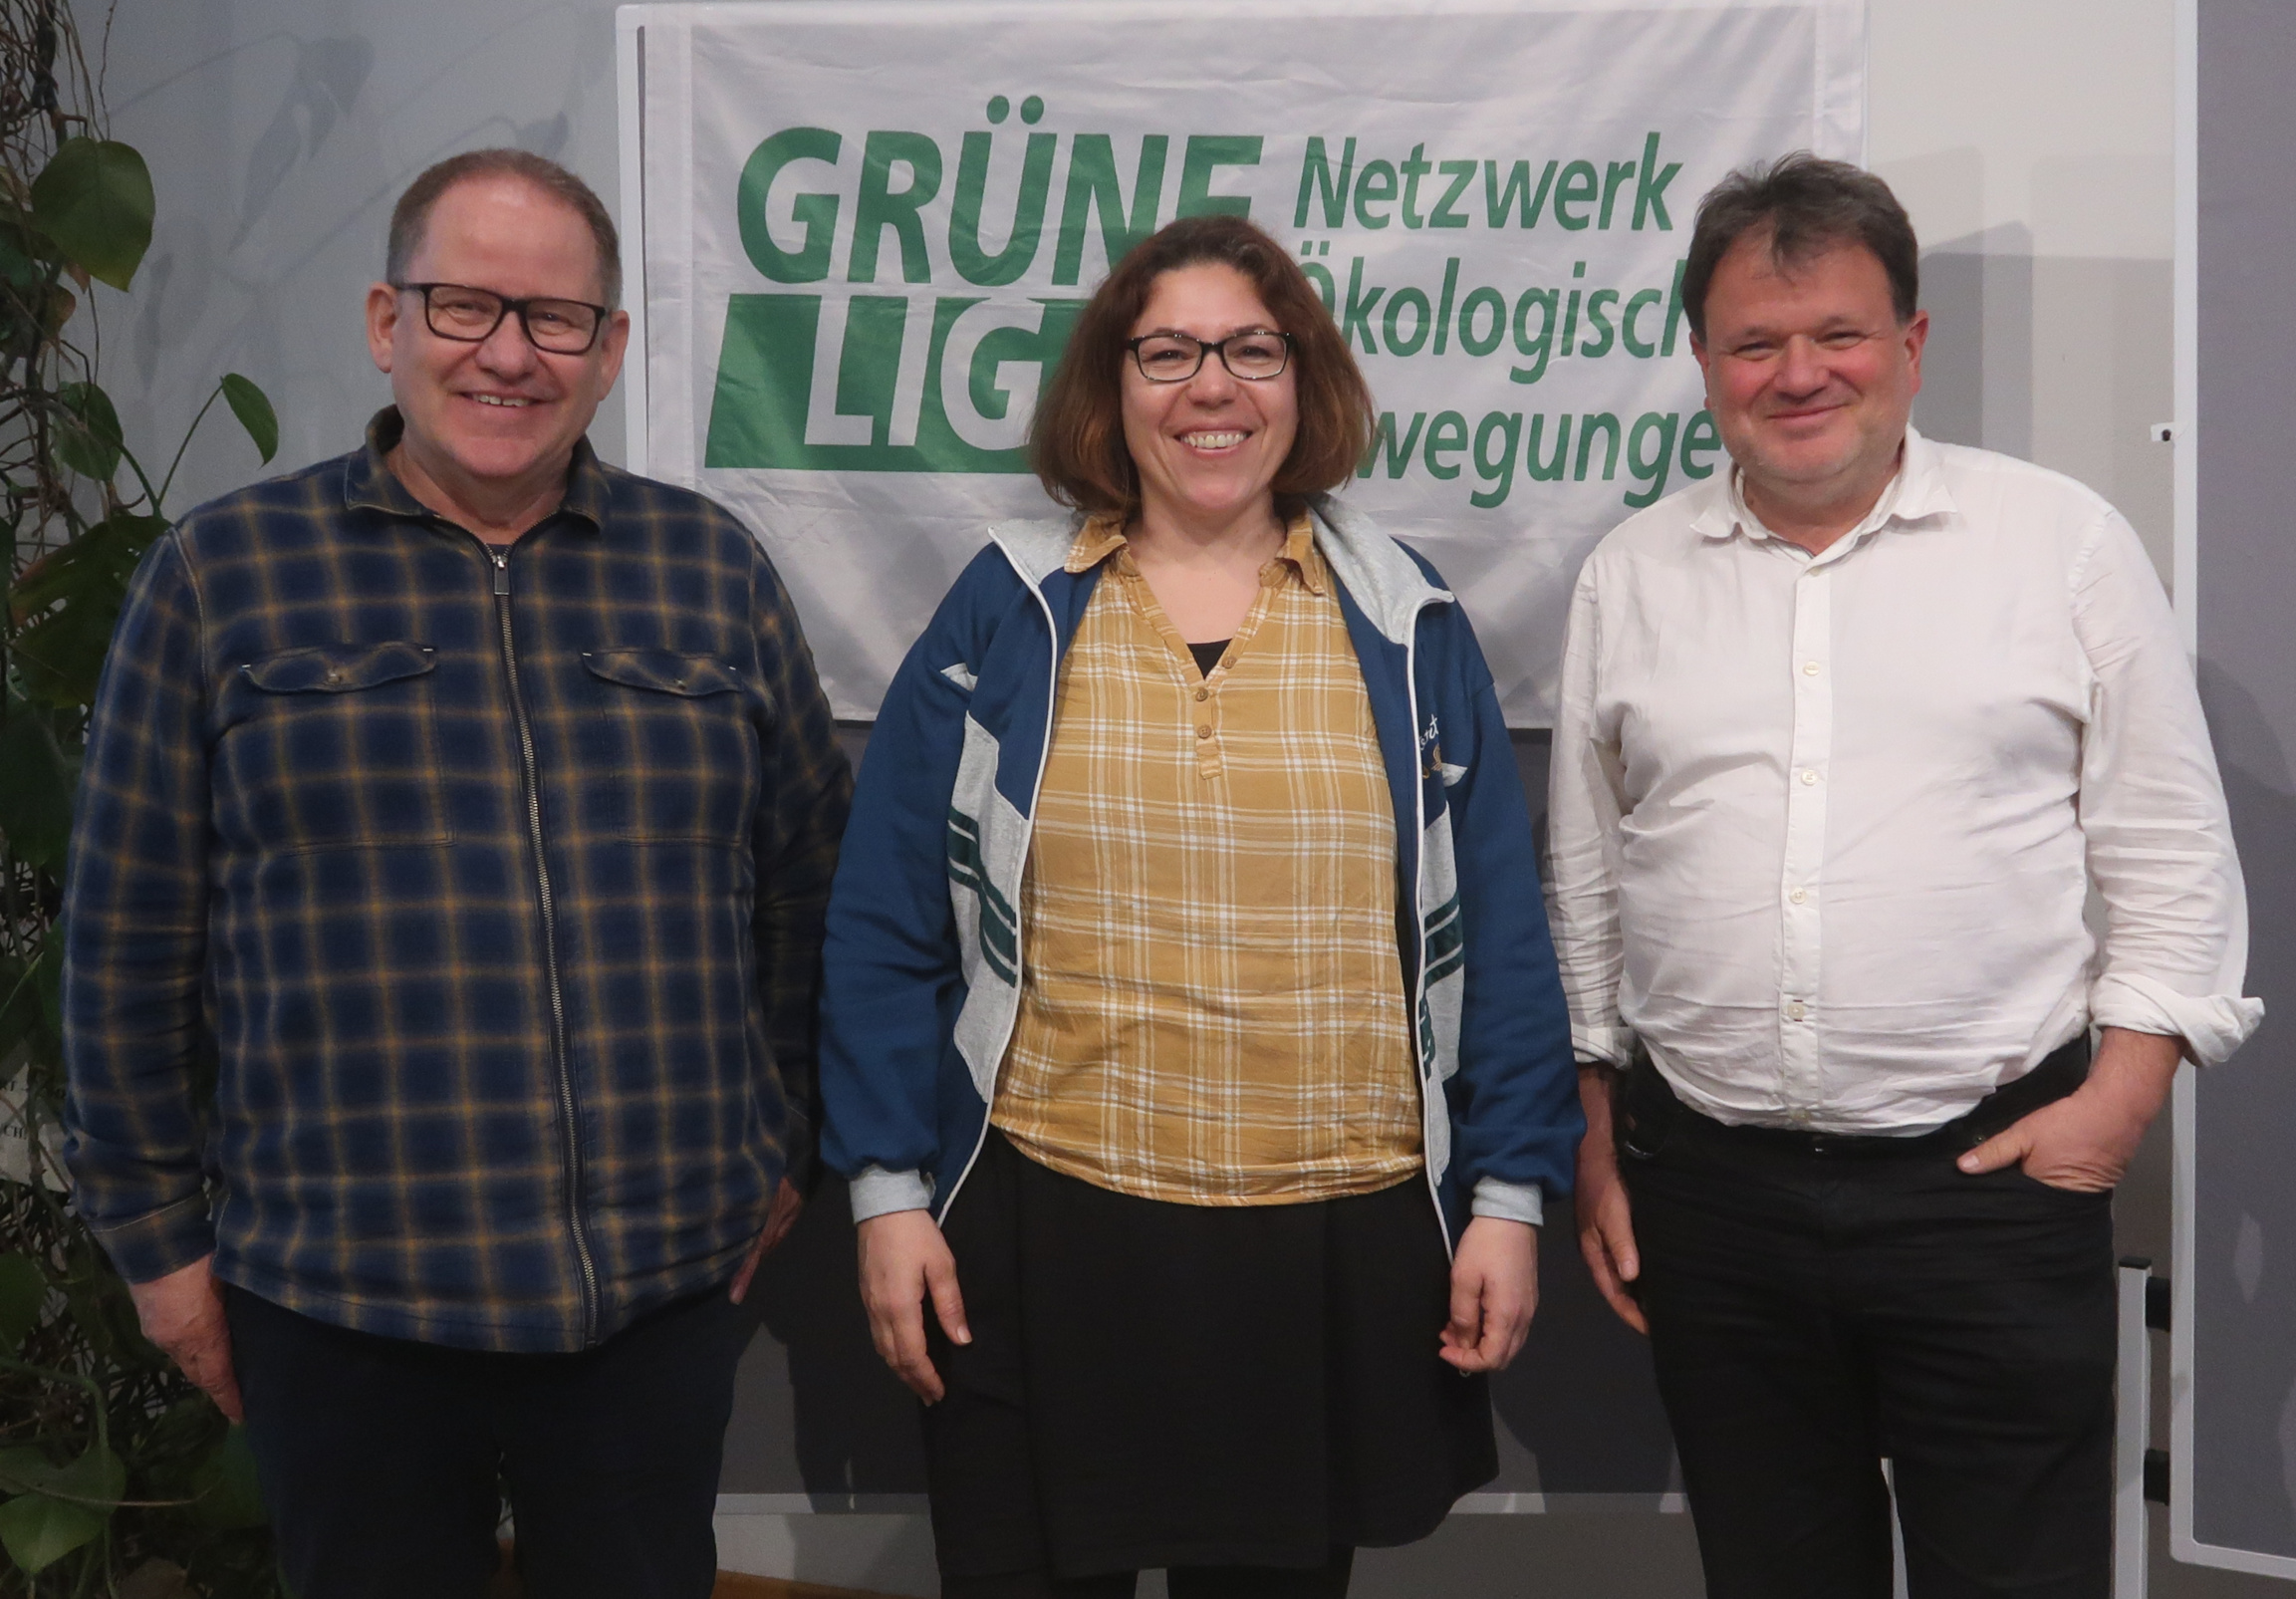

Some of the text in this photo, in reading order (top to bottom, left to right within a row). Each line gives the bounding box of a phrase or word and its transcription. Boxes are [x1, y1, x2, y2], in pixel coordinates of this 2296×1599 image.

[1293, 132, 1683, 231] Netzwerk
[804, 296, 1047, 450] LIG
[1357, 409, 1722, 508] wegunge
